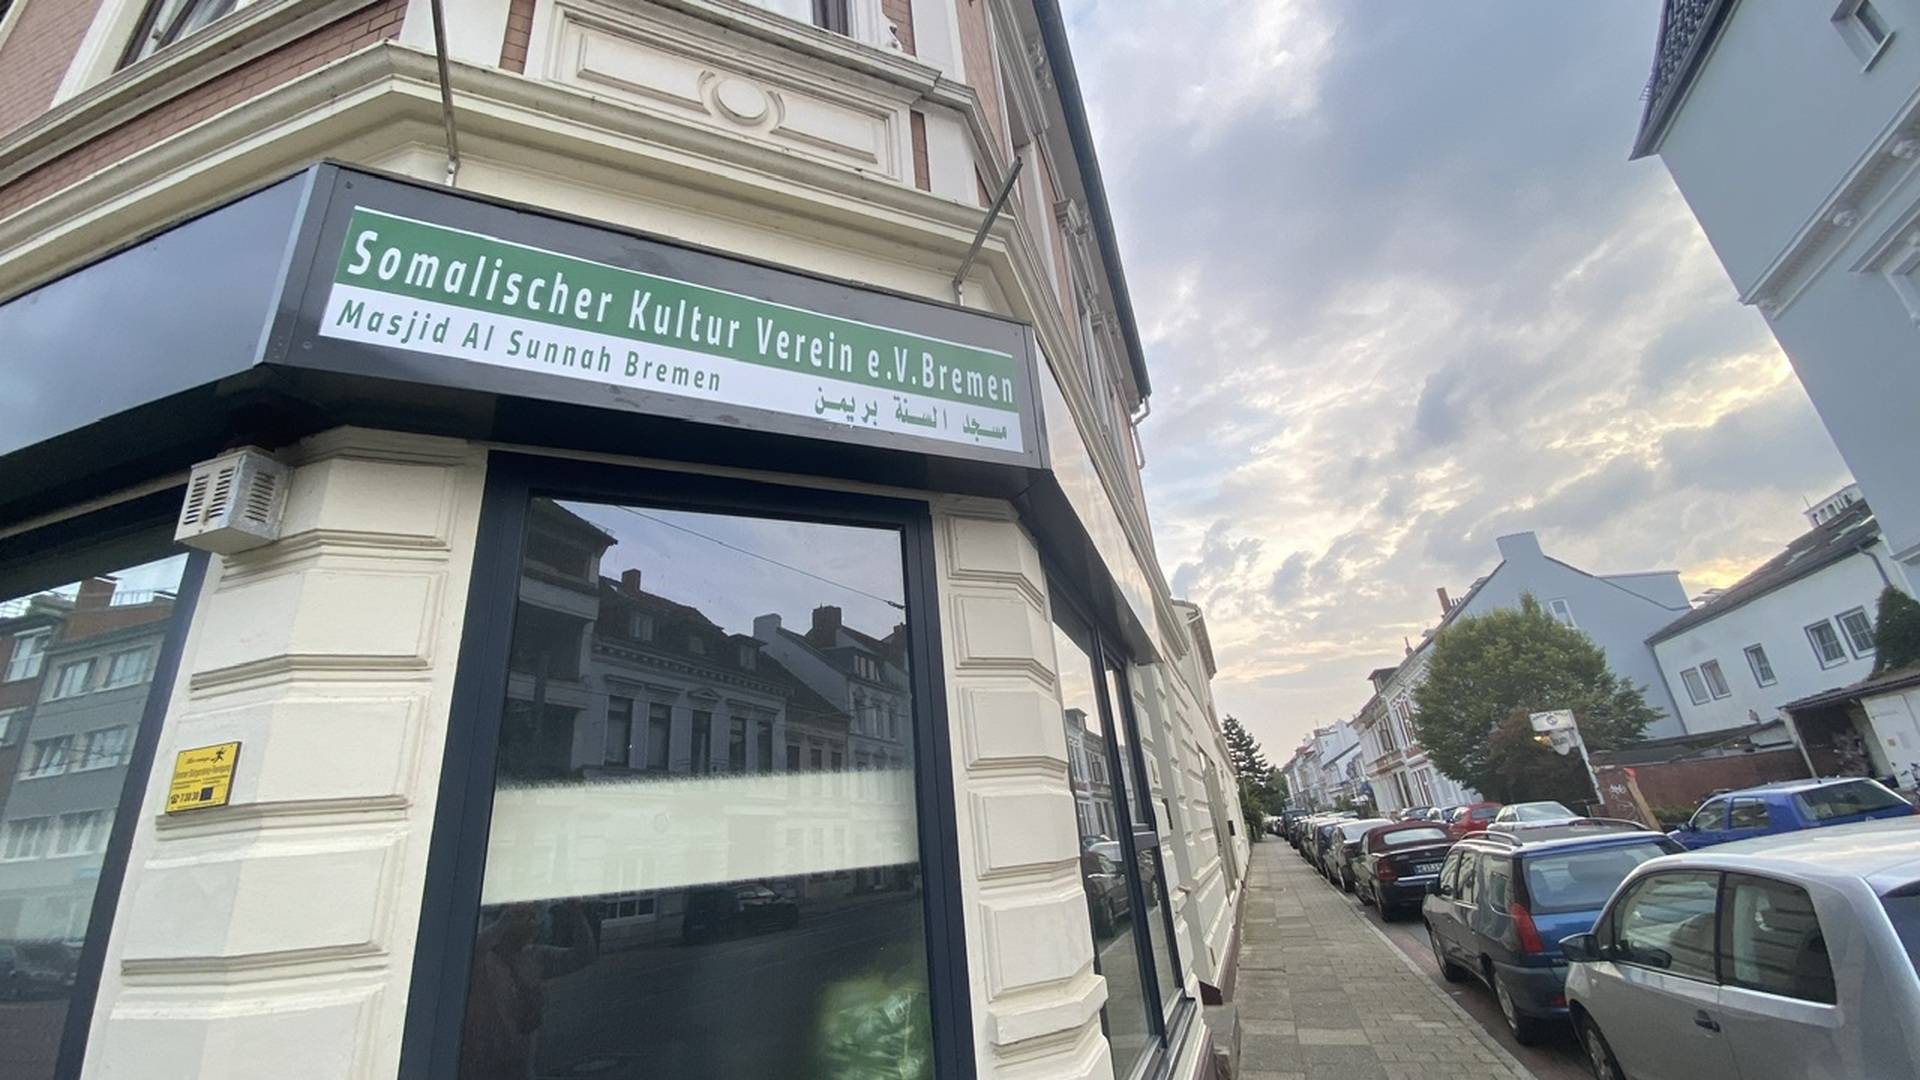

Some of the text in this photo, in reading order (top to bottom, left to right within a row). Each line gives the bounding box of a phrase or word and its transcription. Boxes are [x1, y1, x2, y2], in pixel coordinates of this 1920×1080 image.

[336, 299, 720, 391] Masjid Al Sunnah Bremen
[347, 230, 613, 323] Somalischer
[628, 289, 740, 348] Kultur
[757, 316, 852, 373] Verein
[962, 414, 1008, 442] مسجد
